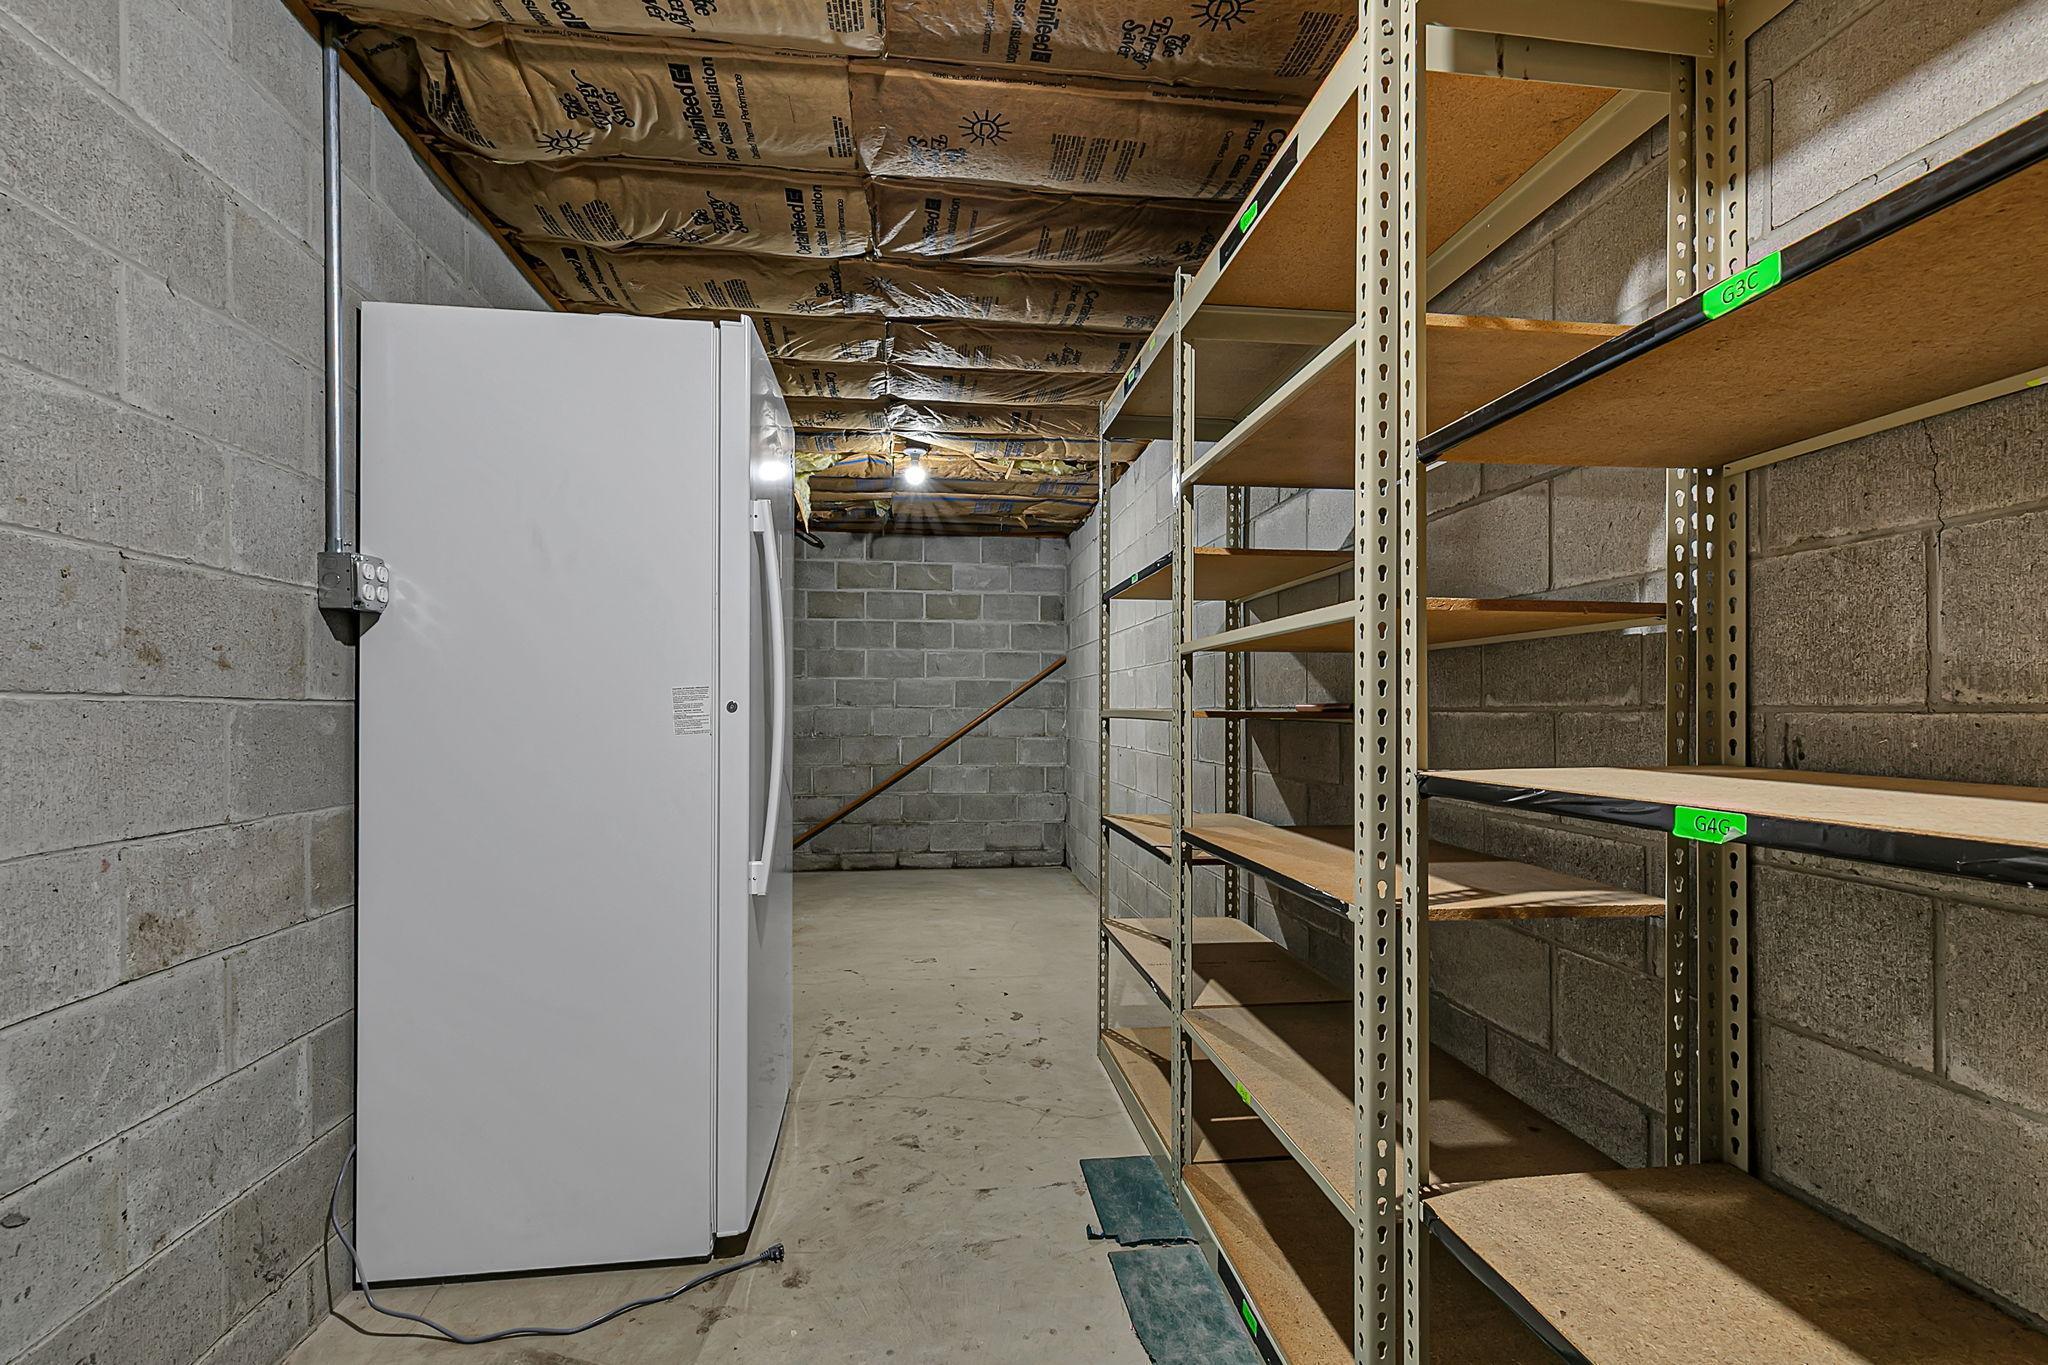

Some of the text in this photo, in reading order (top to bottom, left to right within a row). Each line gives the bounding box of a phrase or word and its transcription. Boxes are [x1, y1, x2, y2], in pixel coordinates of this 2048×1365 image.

[667, 0, 697, 33] ergy
[693, 0, 718, 17] he
[1032, 0, 1063, 51] ainTeed
[1006, 20, 1025, 64] Insulation
[1116, 18, 1147, 60] Saver
[1133, 16, 1174, 71] Energy
[1162, 32, 1191, 58] The
[559, 92, 590, 120] The
[570, 69, 613, 130] Energy
[601, 87, 636, 128] Saver
[701, 56, 727, 119] Insulation
[734, 73, 750, 121] Performance
[673, 83, 718, 157] CertainTeed
[717, 121, 734, 145] Glass
[1243, 119, 1265, 151] Fiber
[706, 190, 730, 235] Energy
[727, 201, 749, 234] Saver
[811, 184, 828, 230] Insulation
[787, 202, 812, 255] CertainTeed
[1722, 271, 1758, 304] G3C
[1695, 815, 1731, 836] G4G
